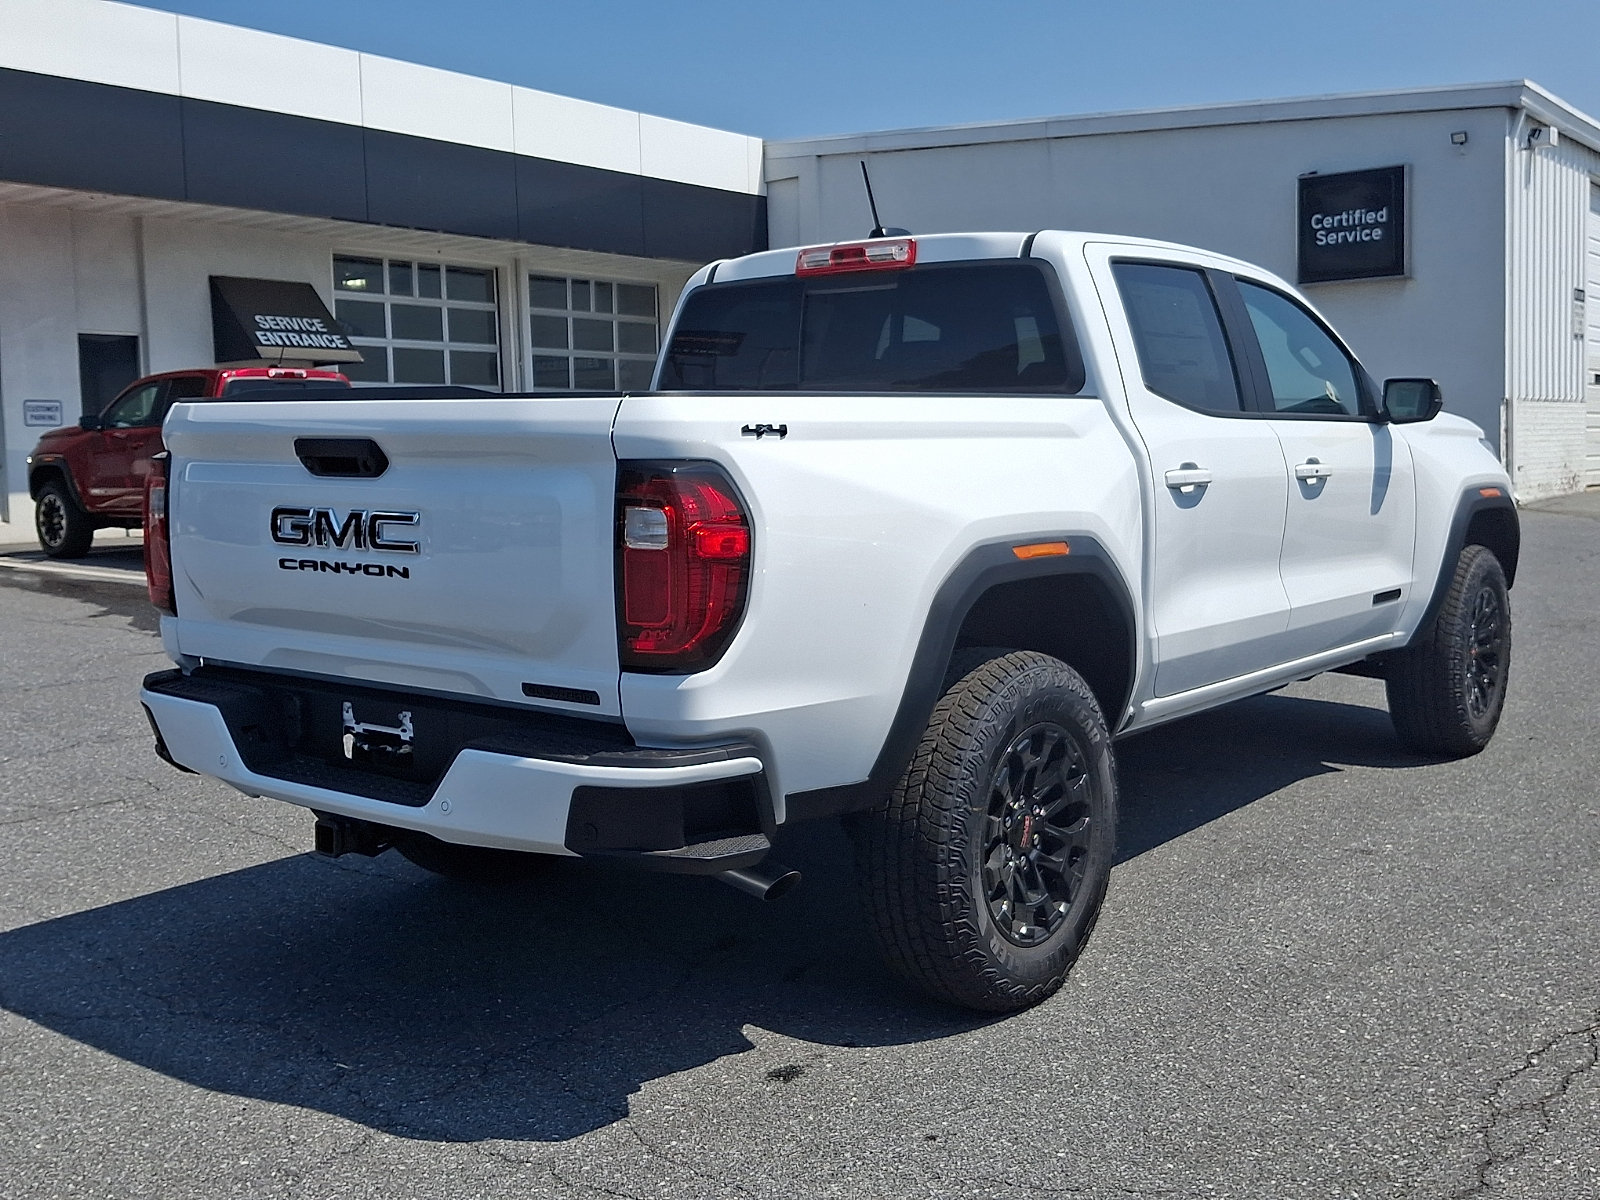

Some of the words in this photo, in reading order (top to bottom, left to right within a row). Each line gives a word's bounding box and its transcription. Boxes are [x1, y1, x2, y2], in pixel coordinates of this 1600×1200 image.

[1311, 206, 1387, 229] Certified
[1316, 226, 1382, 245] Service
[254, 315, 328, 332] SERVICE
[254, 330, 348, 348] ENTRANCE
[270, 504, 420, 555] GMC
[278, 558, 410, 579] CANYON
